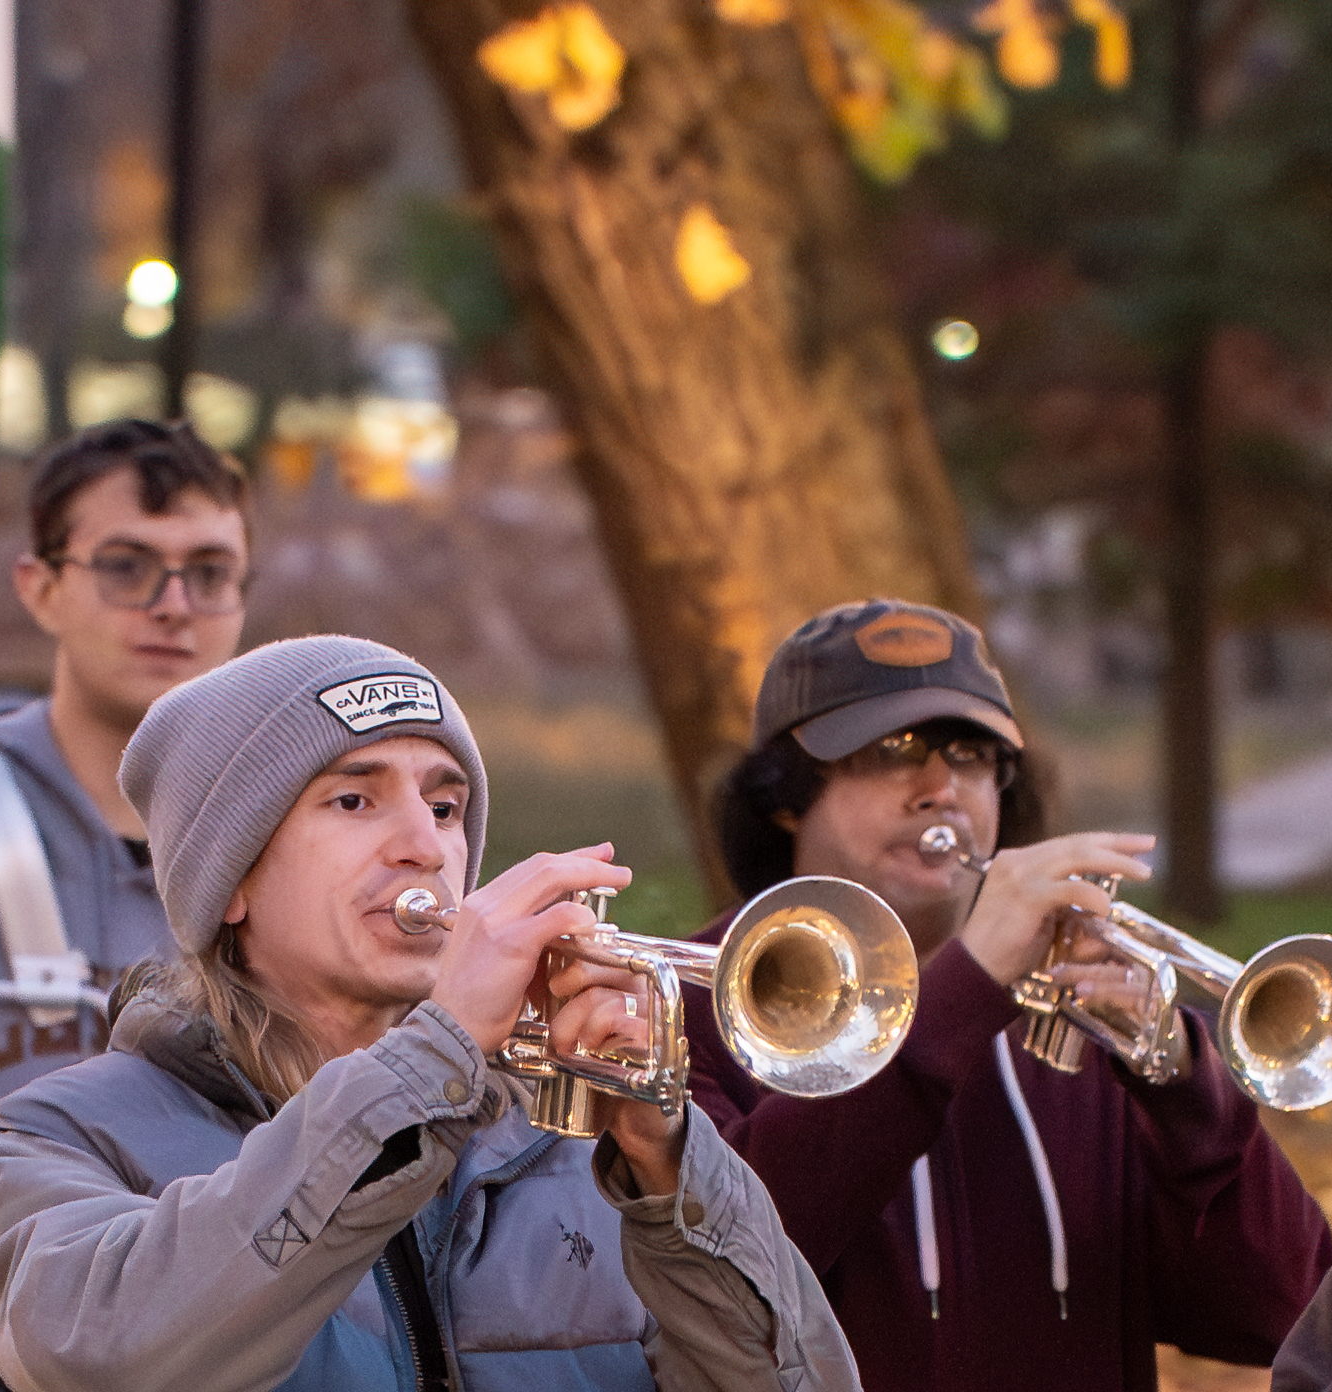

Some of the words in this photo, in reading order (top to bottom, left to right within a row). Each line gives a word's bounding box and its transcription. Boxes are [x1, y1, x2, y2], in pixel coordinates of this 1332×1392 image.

[336, 698, 353, 709] CA
[348, 681, 420, 706] VANS
[346, 708, 377, 722] SINCE
